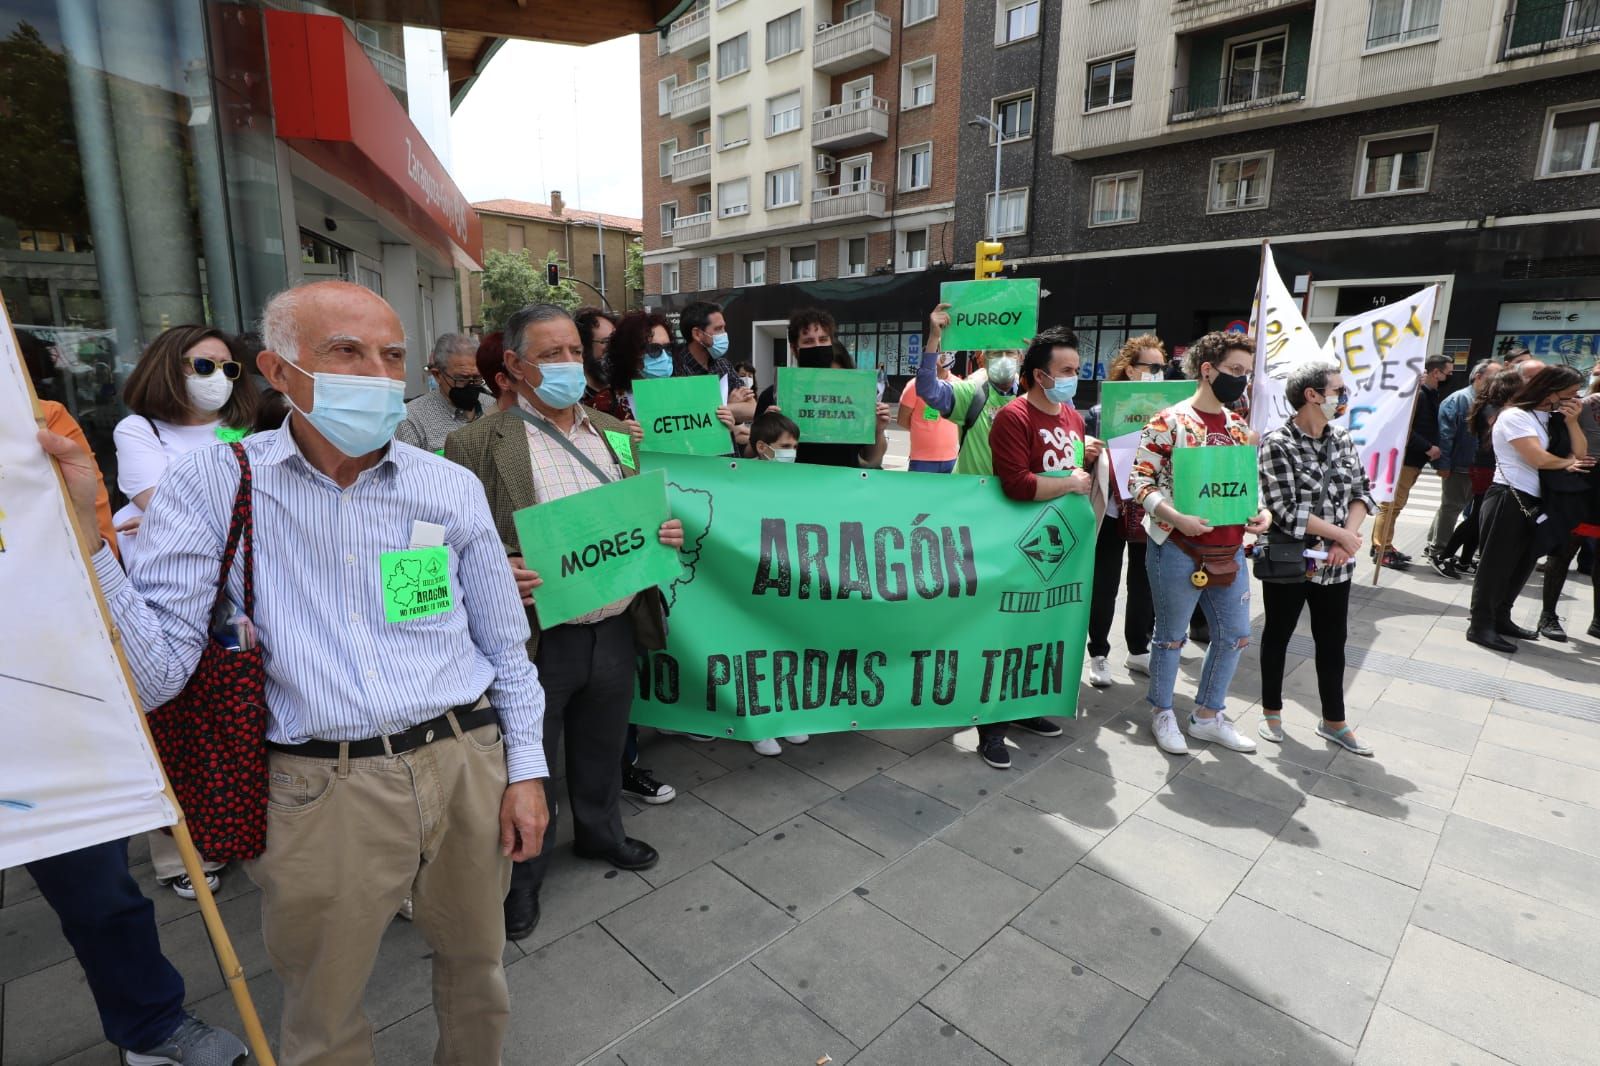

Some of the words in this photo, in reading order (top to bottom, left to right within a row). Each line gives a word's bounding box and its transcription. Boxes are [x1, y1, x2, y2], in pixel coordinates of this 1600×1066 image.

[956, 311, 1022, 327] PURROY
[804, 394, 853, 404] PUEBLA
[653, 412, 713, 434] CETINA
[798, 409, 815, 418] DE
[1199, 481, 1248, 499] ARIZA
[561, 527, 645, 578] MORES
[751, 512, 978, 601] ARAGÓN
[417, 585, 448, 604] ARAGÓN
[706, 647, 888, 717] PIERDAS
[911, 649, 959, 707] TU
[979, 640, 1066, 703] TREN
